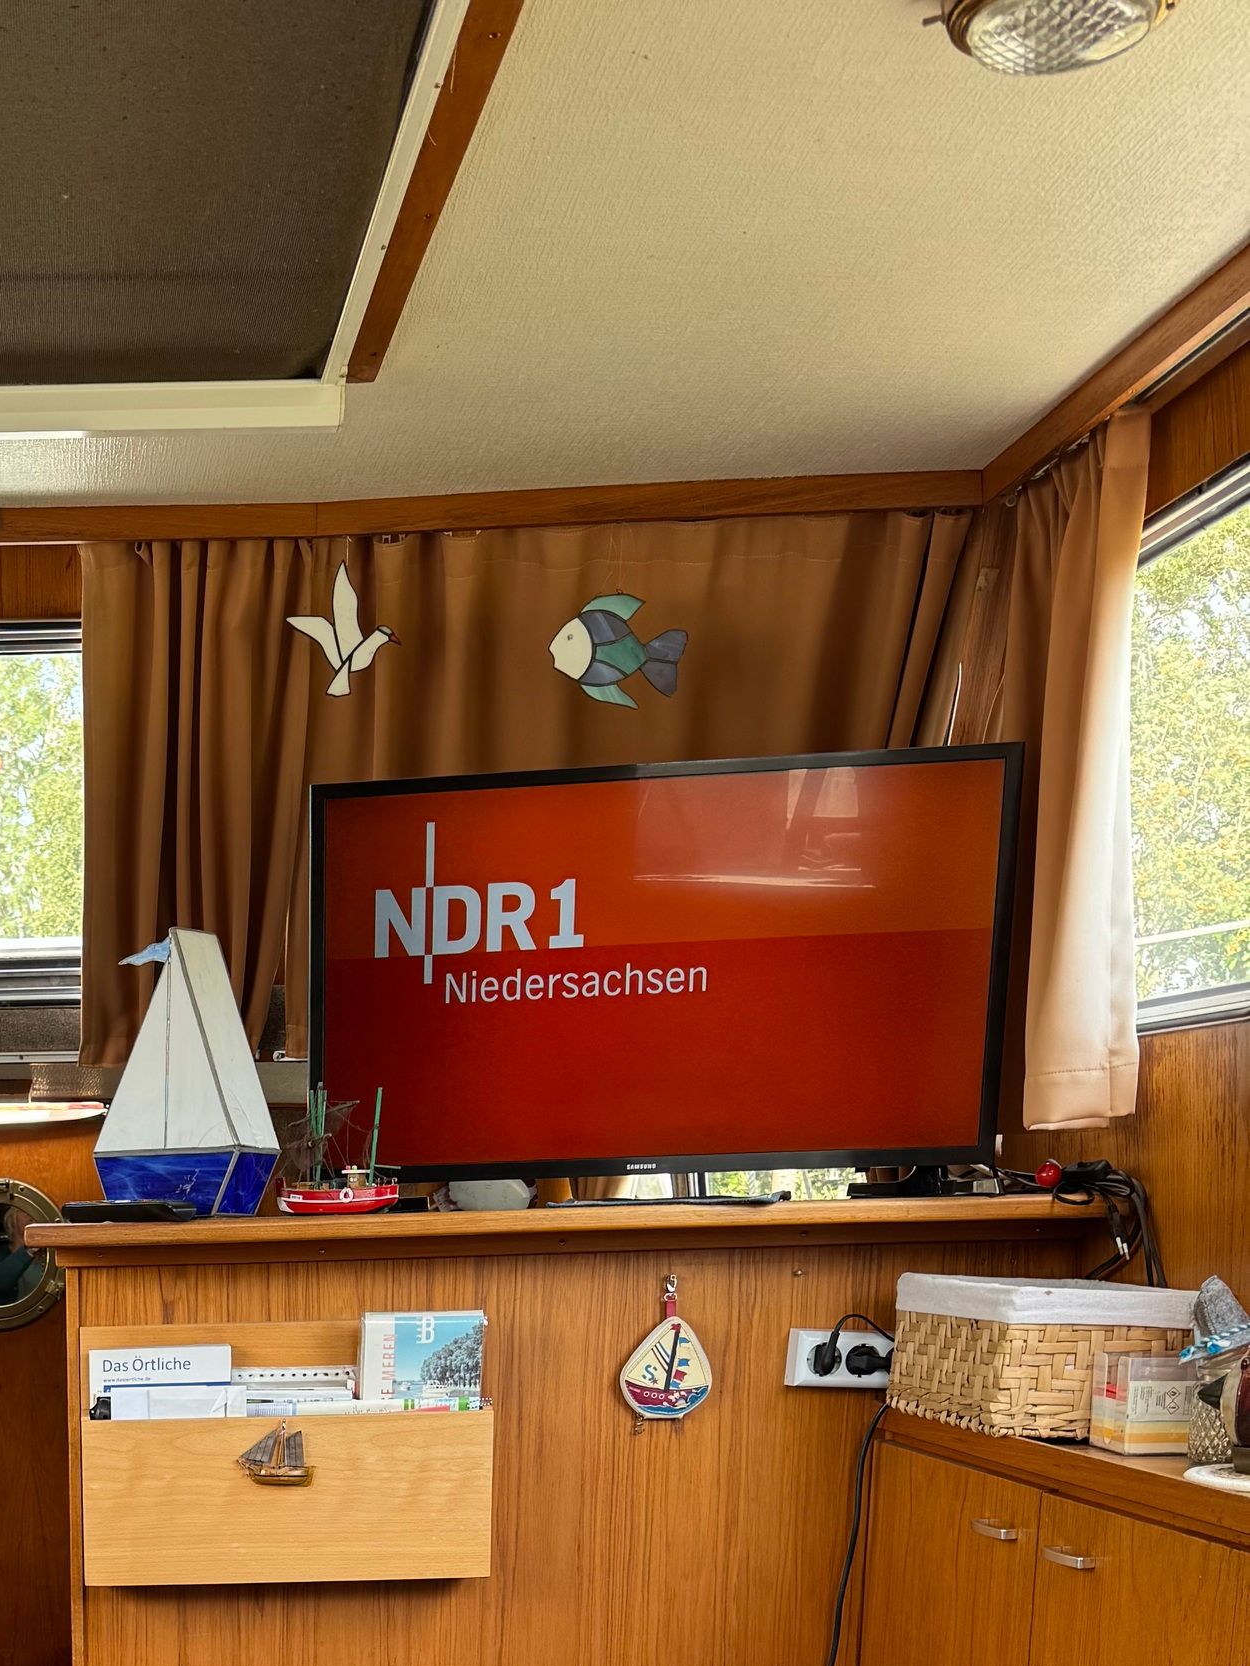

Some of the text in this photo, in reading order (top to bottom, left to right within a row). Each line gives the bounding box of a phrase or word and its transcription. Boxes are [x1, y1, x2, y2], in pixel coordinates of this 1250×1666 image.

[445, 962, 709, 1004] Niedersachsen
[102, 1355, 191, 1373] Das Örtliche
